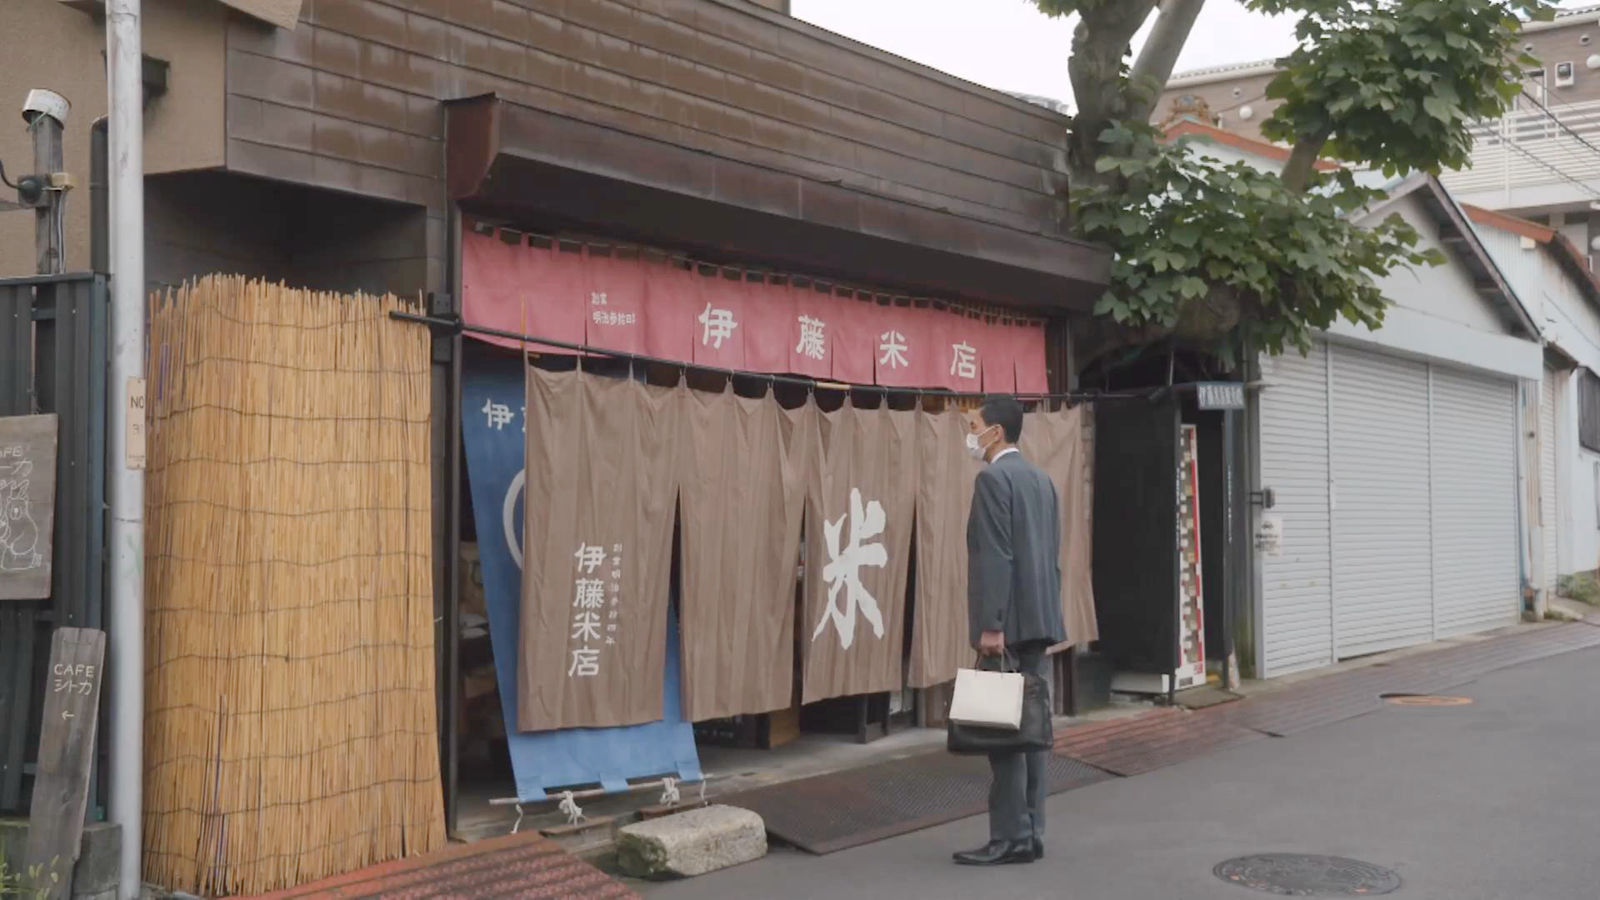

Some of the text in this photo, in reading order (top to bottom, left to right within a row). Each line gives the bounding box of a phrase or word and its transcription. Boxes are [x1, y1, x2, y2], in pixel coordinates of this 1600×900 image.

[698, 302, 977, 379] 伊藤米店
[481, 398, 526, 433] 伊
[811, 487, 888, 650] 米
[568, 542, 607, 677] 伊藤米店
[54, 663, 95, 677] CAFE
[54, 679, 93, 695] シトカ
